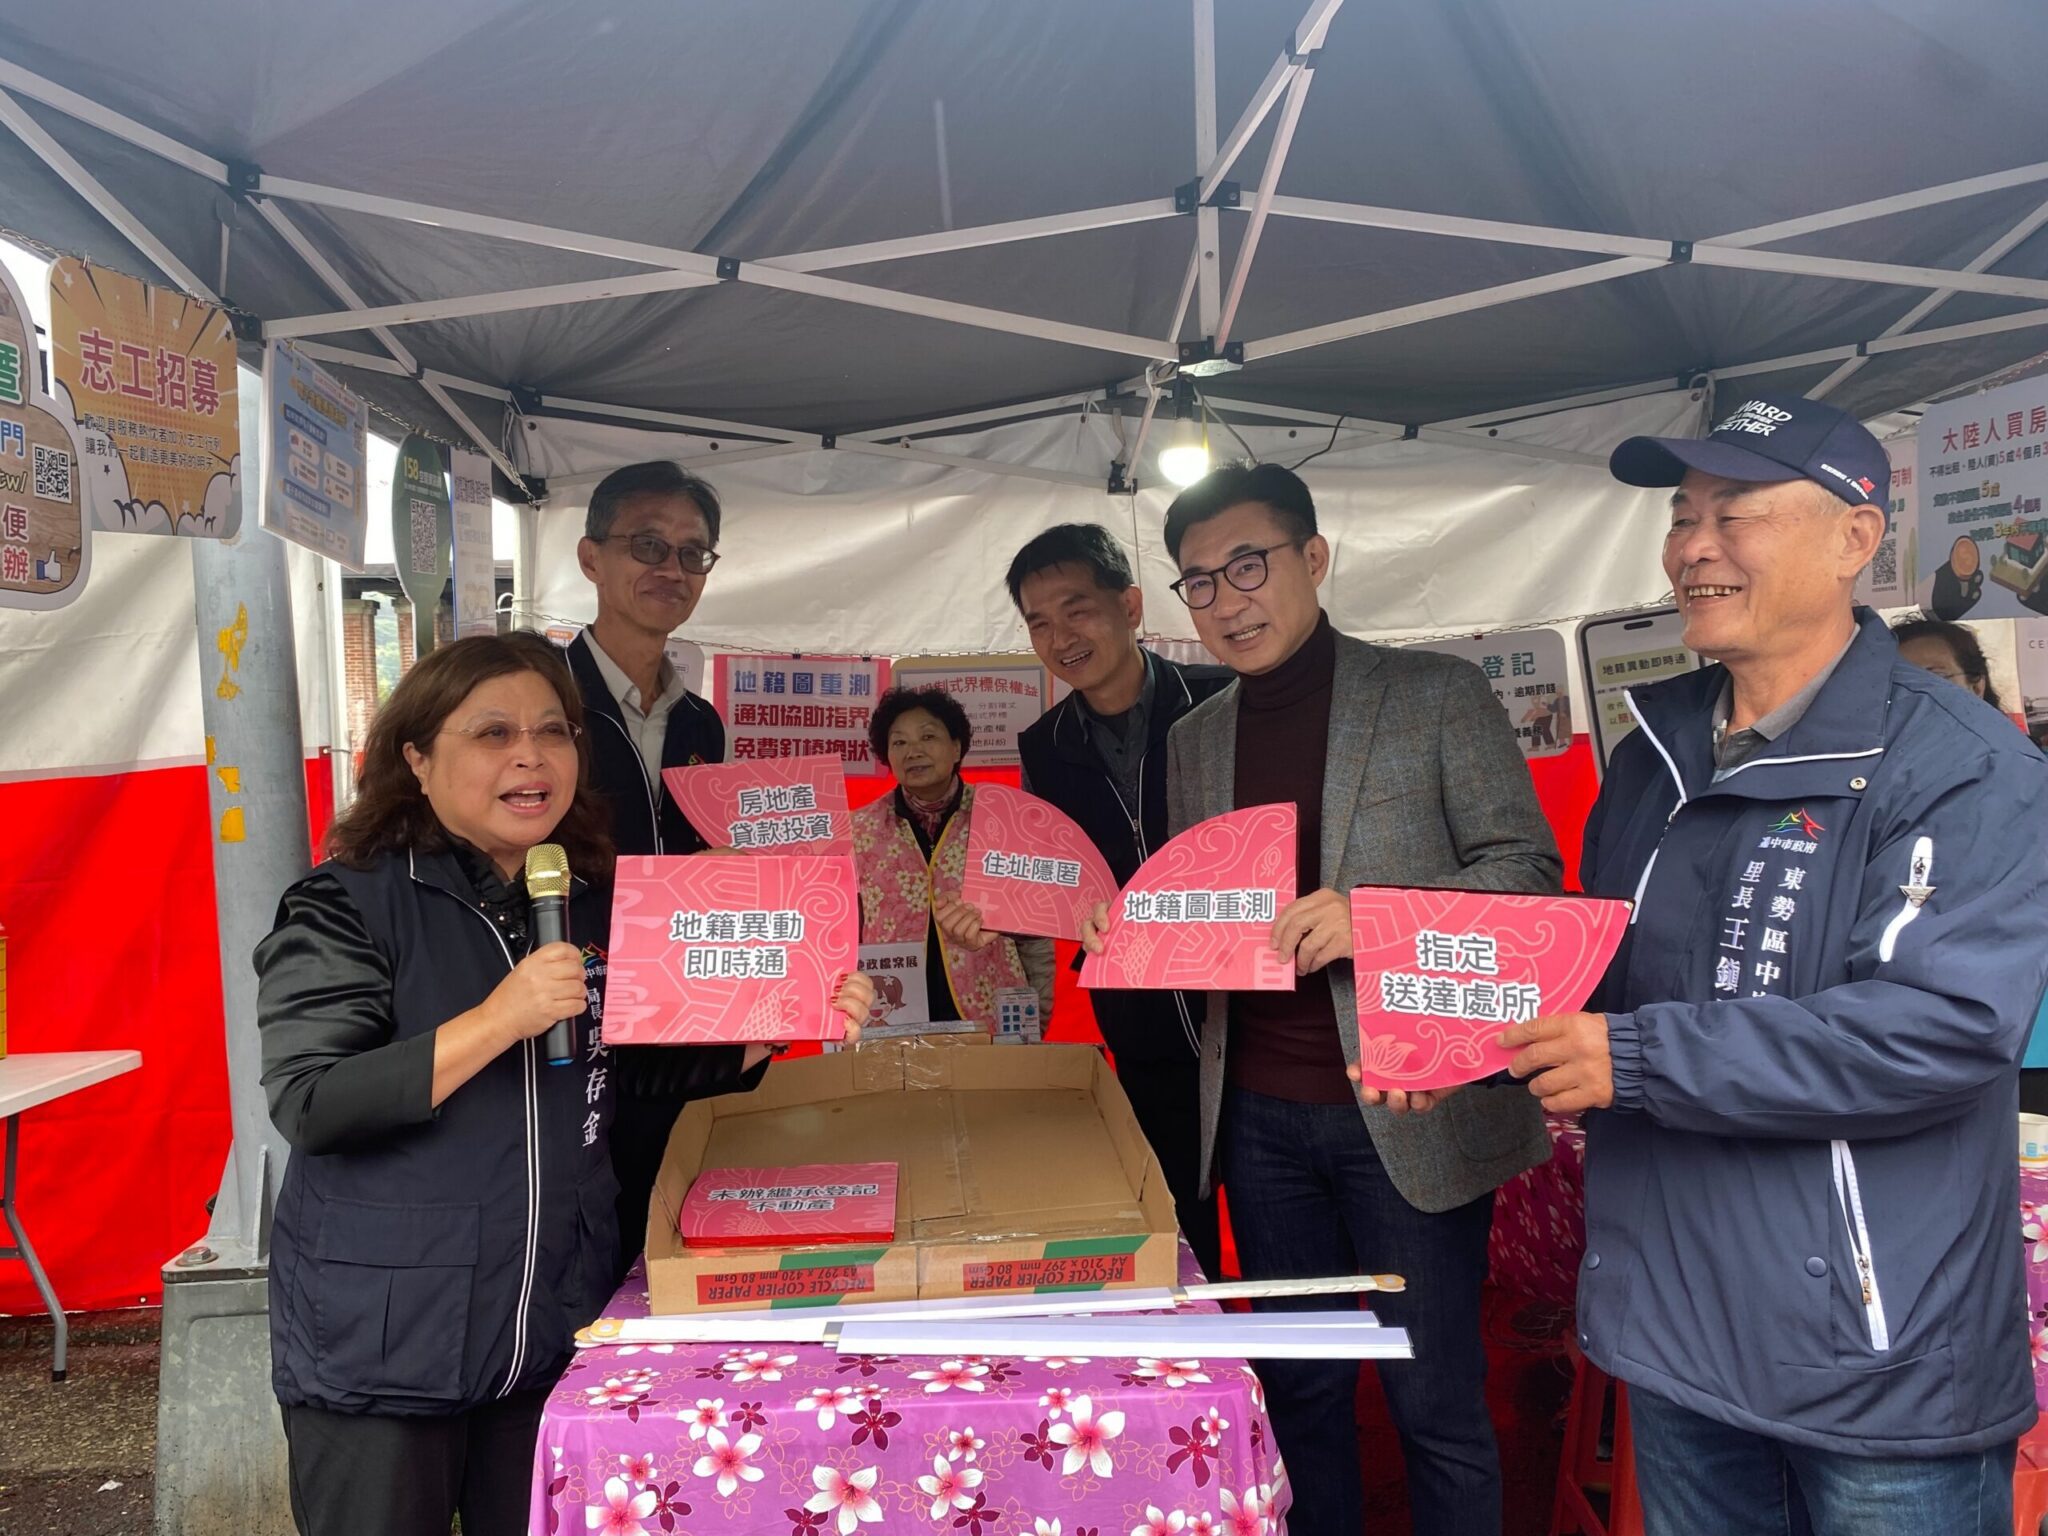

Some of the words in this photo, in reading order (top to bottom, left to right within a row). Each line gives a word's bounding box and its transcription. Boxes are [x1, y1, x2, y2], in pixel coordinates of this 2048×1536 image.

[79, 328, 220, 416] 志工招募
[1942, 405, 2048, 454] 大陸人買房
[2, 505, 28, 540] 便
[3, 547, 29, 582] 辦
[2029, 640, 2048, 649] CE
[1482, 652, 1536, 679] 登記
[1602, 653, 1686, 675] 地籍異動即時通
[734, 670, 871, 696] 地籍圖重測
[734, 703, 870, 729] 通知協助指界
[739, 785, 815, 817] 房地產
[730, 815, 833, 848] 貸款投資
[983, 852, 1081, 885] 住址隱匿
[1124, 891, 1275, 921] 地籍圖重測
[671, 911, 803, 941] 地籍異動
[1752, 866, 1807, 998] 東勢區中
[1418, 932, 1497, 972] 指定
[686, 948, 785, 978] 即時通
[1383, 975, 1540, 1021] 送達處所
[709, 1185, 879, 1200] 未辦繼承登記
[748, 1200, 835, 1212] 不動產
[998, 1264, 1011, 1274] 80
[1021, 1263, 1041, 1271] mm
[1044, 1261, 1066, 1272] 297
[1082, 1258, 1102, 1269] 210
[1109, 1256, 1127, 1267] A4
[714, 1273, 739, 1283] Gsm
[742, 1272, 755, 1282] 80
[759, 1272, 779, 1280] mm
[782, 1270, 802, 1280] 420
[819, 1268, 839, 1278] 297
[1017, 1272, 1064, 1285] COPIER
[1068, 1268, 1123, 1283] RECYCLE
[756, 1282, 804, 1296] COPIER
[809, 1277, 866, 1293] RECYCLE
[970, 1276, 1011, 1288] PAPER
[708, 1286, 751, 1300] PAPER
